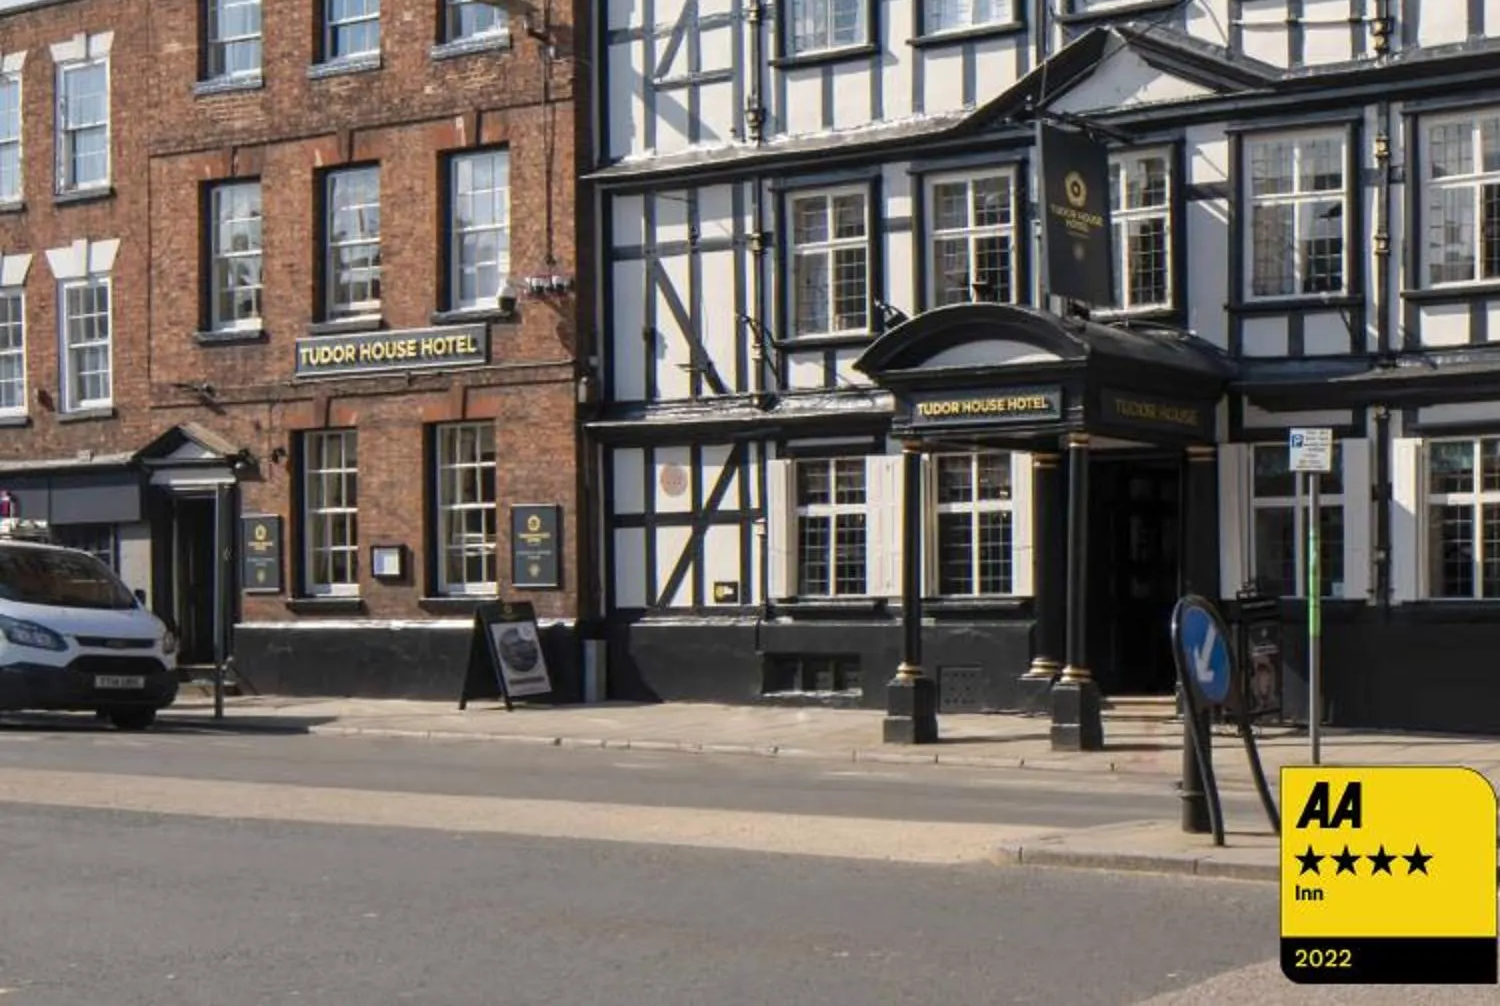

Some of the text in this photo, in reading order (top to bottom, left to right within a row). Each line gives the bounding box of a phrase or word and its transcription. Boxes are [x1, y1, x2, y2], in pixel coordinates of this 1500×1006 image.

[299, 334, 477, 366] TUDOR HOUSE HOTEL
[916, 396, 1048, 417] TUDOR HOUSE HOTEL
